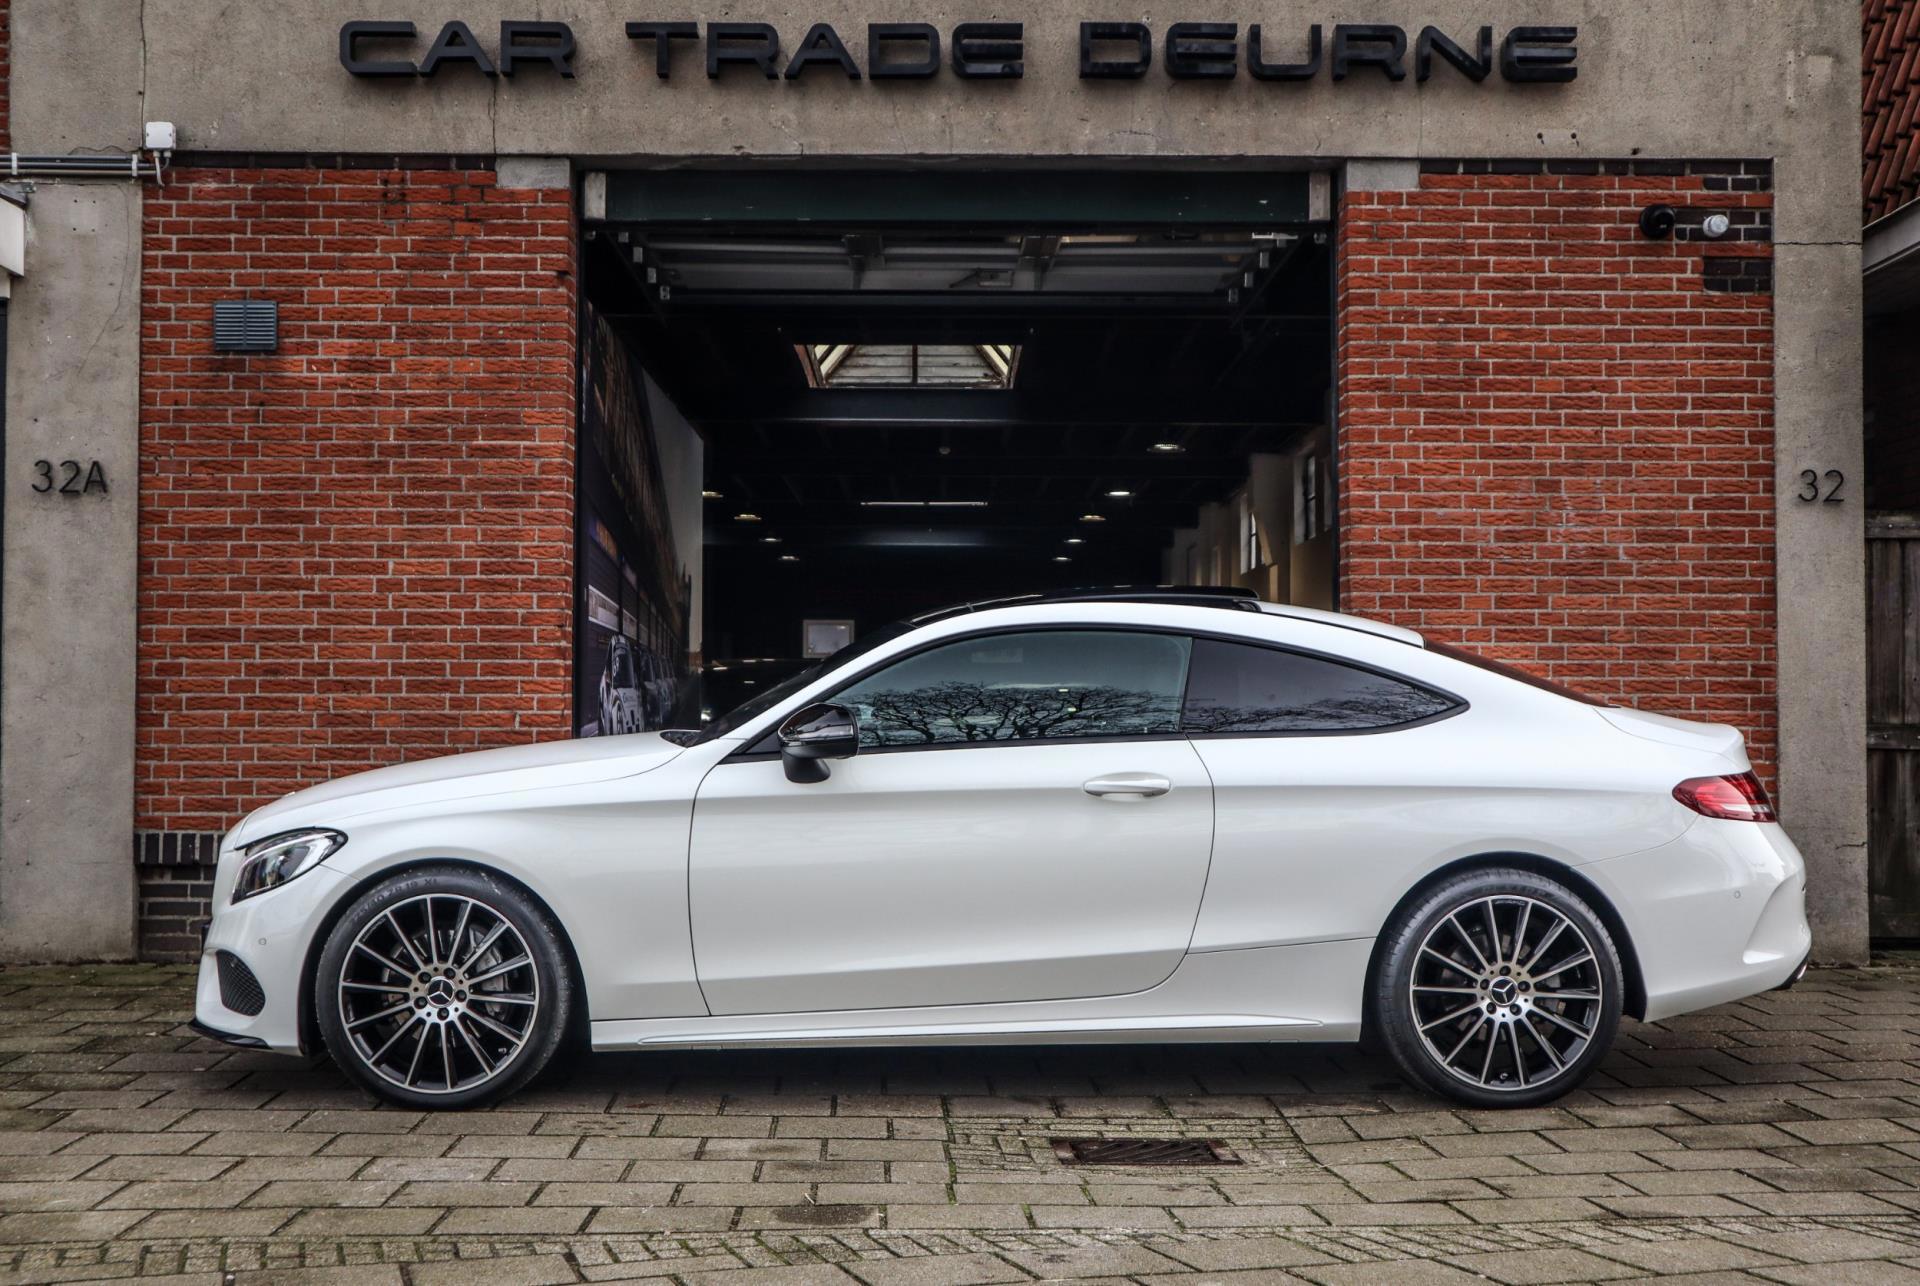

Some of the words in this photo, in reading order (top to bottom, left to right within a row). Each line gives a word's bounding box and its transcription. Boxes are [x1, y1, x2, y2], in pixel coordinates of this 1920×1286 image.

[339, 20, 576, 80] CAR
[625, 22, 1024, 80] TRADE
[1079, 22, 1578, 83] DEURNE
[31, 460, 108, 493] 32A
[1798, 469, 1845, 502] 32
